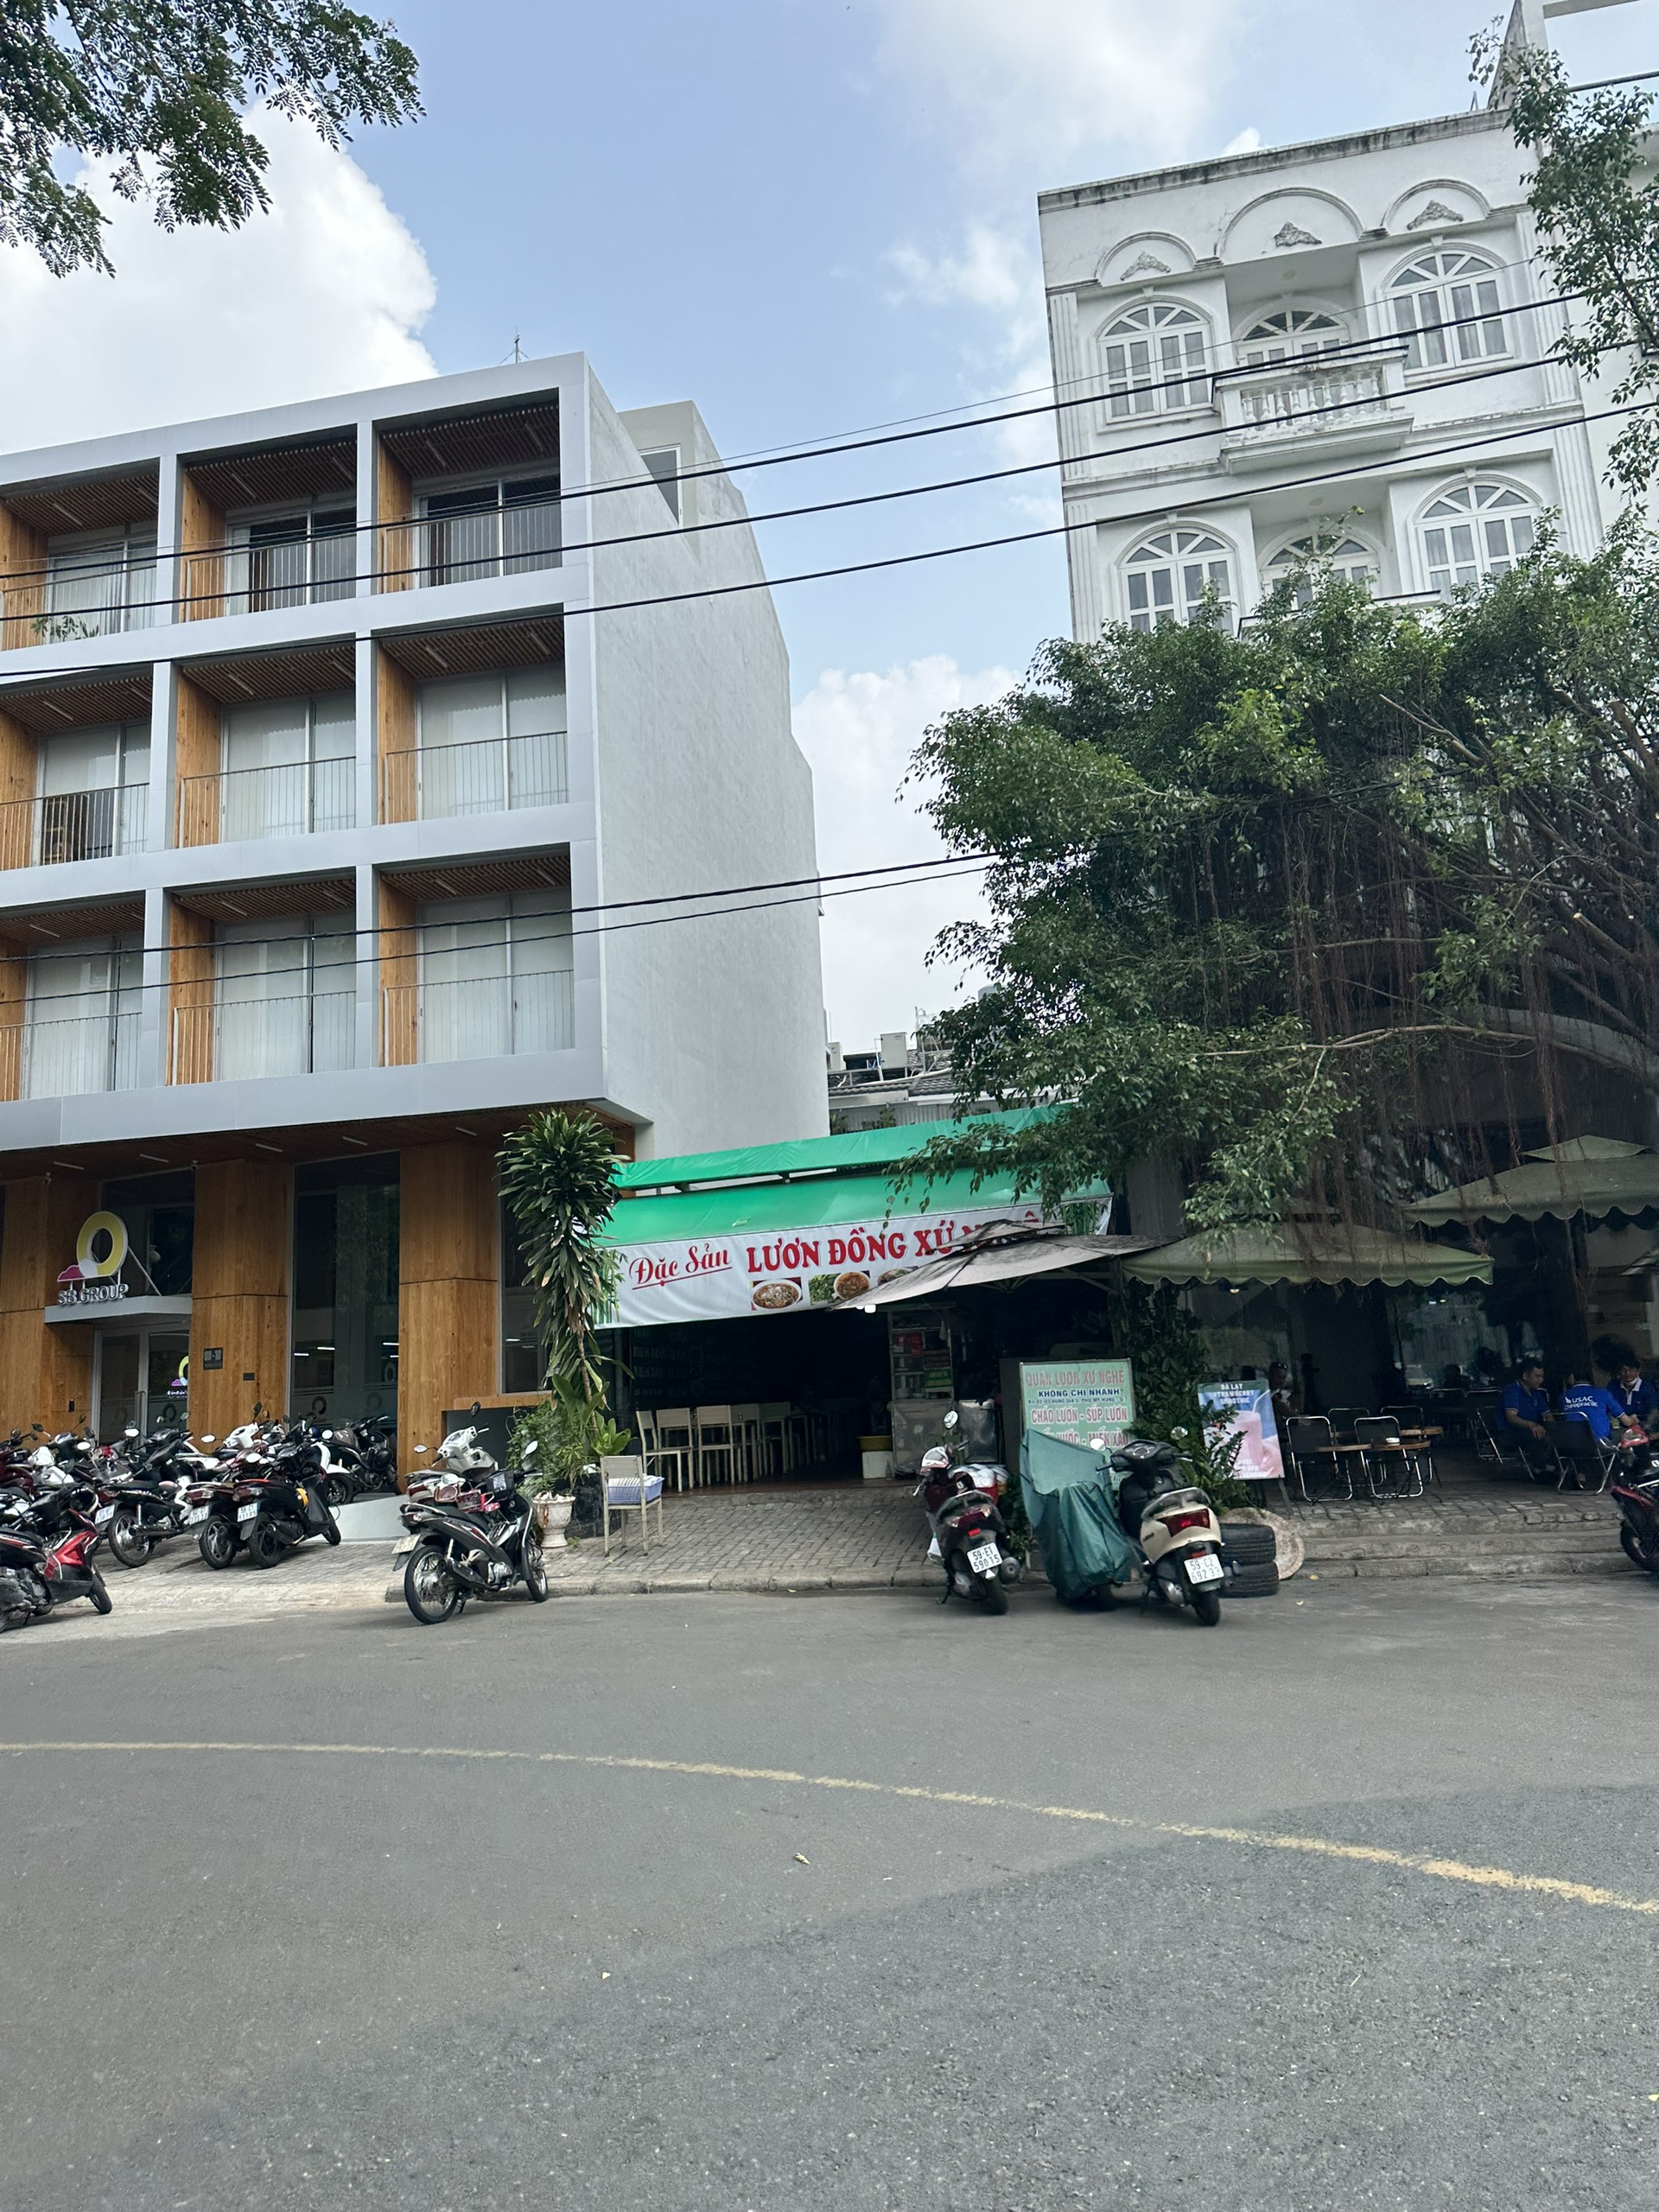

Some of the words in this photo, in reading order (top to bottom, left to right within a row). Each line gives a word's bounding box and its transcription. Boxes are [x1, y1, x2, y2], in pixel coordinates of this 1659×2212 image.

[628, 1256, 681, 1286] Đặc
[685, 1243, 732, 1273] Sản
[746, 1236, 820, 1274] LƯƠN
[829, 1226, 906, 1265] ĐỒNG
[58, 1290, 78, 1305] SB
[79, 1283, 129, 1302] GROUP
[972, 1547, 994, 1560] 59-E1
[1190, 1558, 1214, 1570] 59-C2
